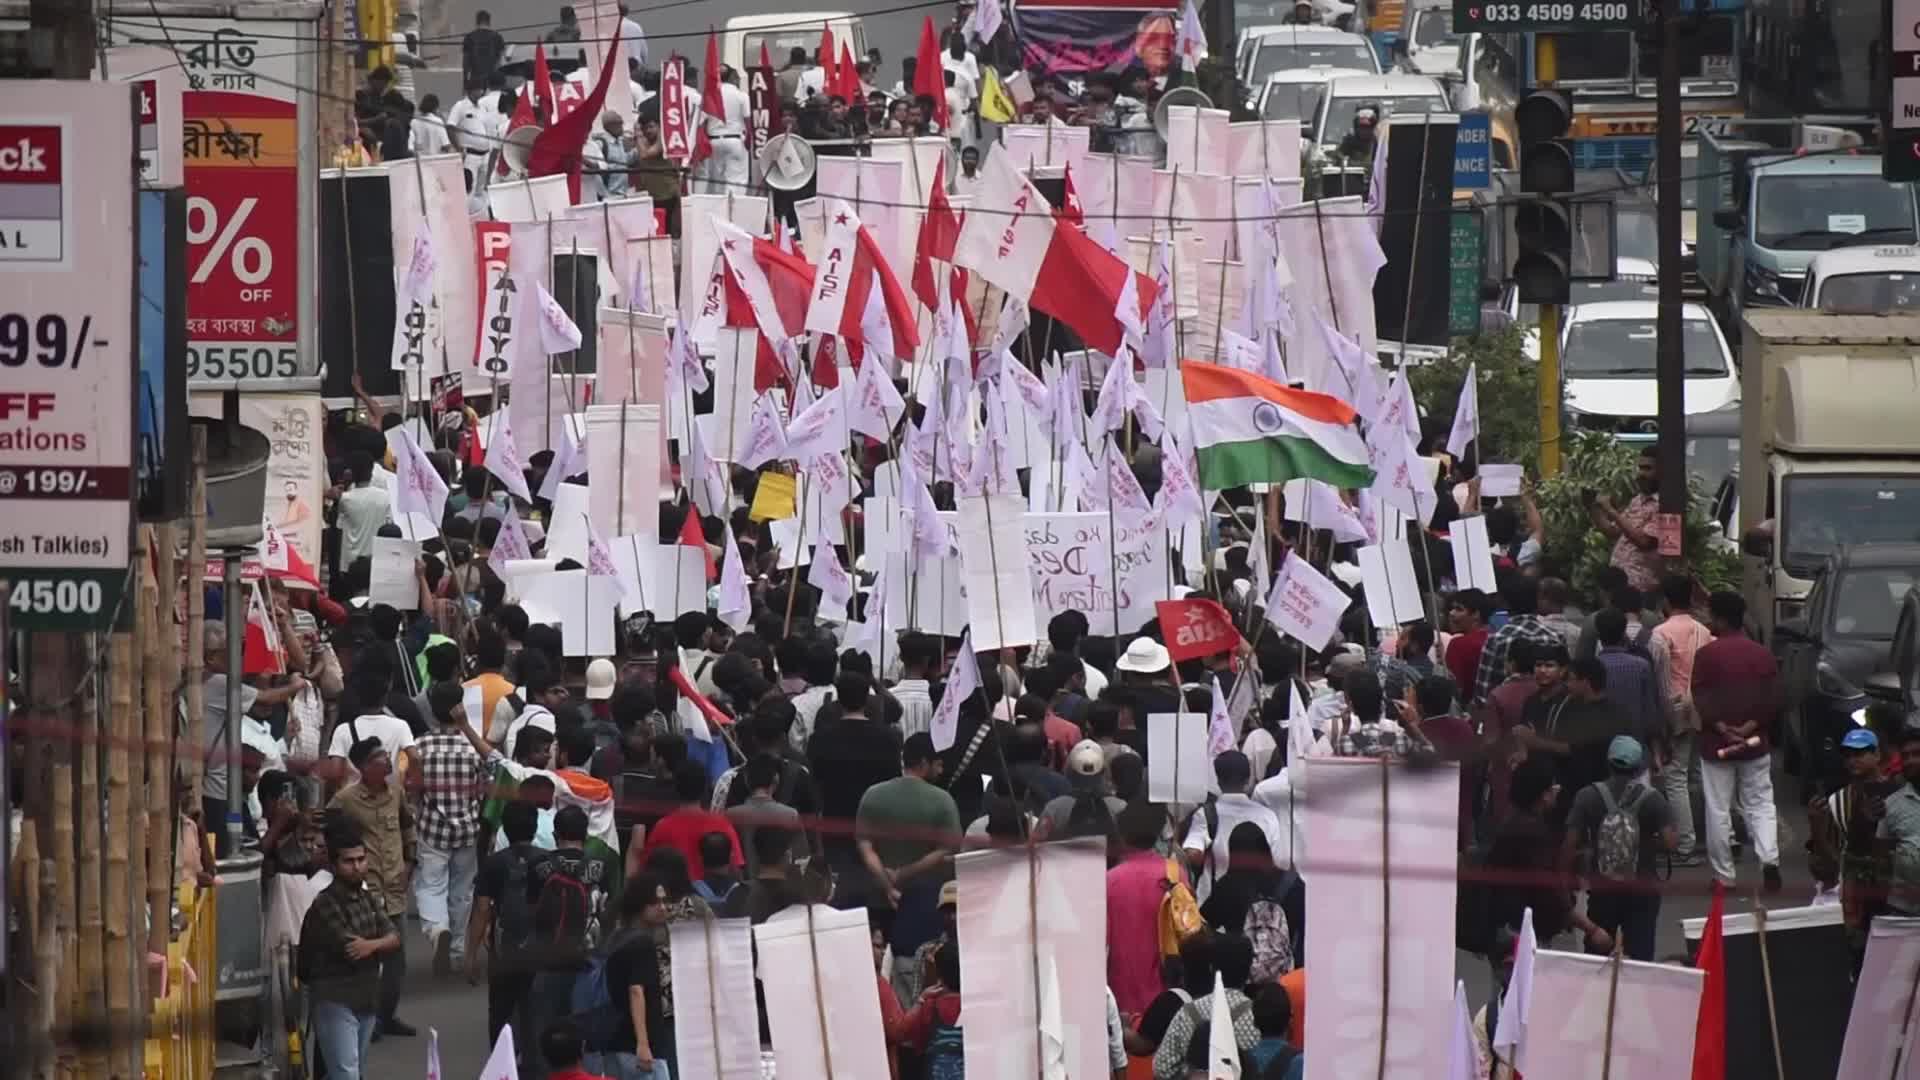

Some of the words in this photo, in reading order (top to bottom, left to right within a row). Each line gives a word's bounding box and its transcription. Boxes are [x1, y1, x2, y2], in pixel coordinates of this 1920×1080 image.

[1486, 5, 1520, 21] 033
[1527, 5, 1574, 21] 4509
[1580, 4, 1627, 20] 4500
[663, 65, 687, 149] AISA
[819, 248, 842, 300] AISF
[240, 289, 272, 302] OFF
[25, 470, 98, 493] 199/-
[32, 535, 109, 557] Talkies)
[10, 580, 101, 613] 4500
